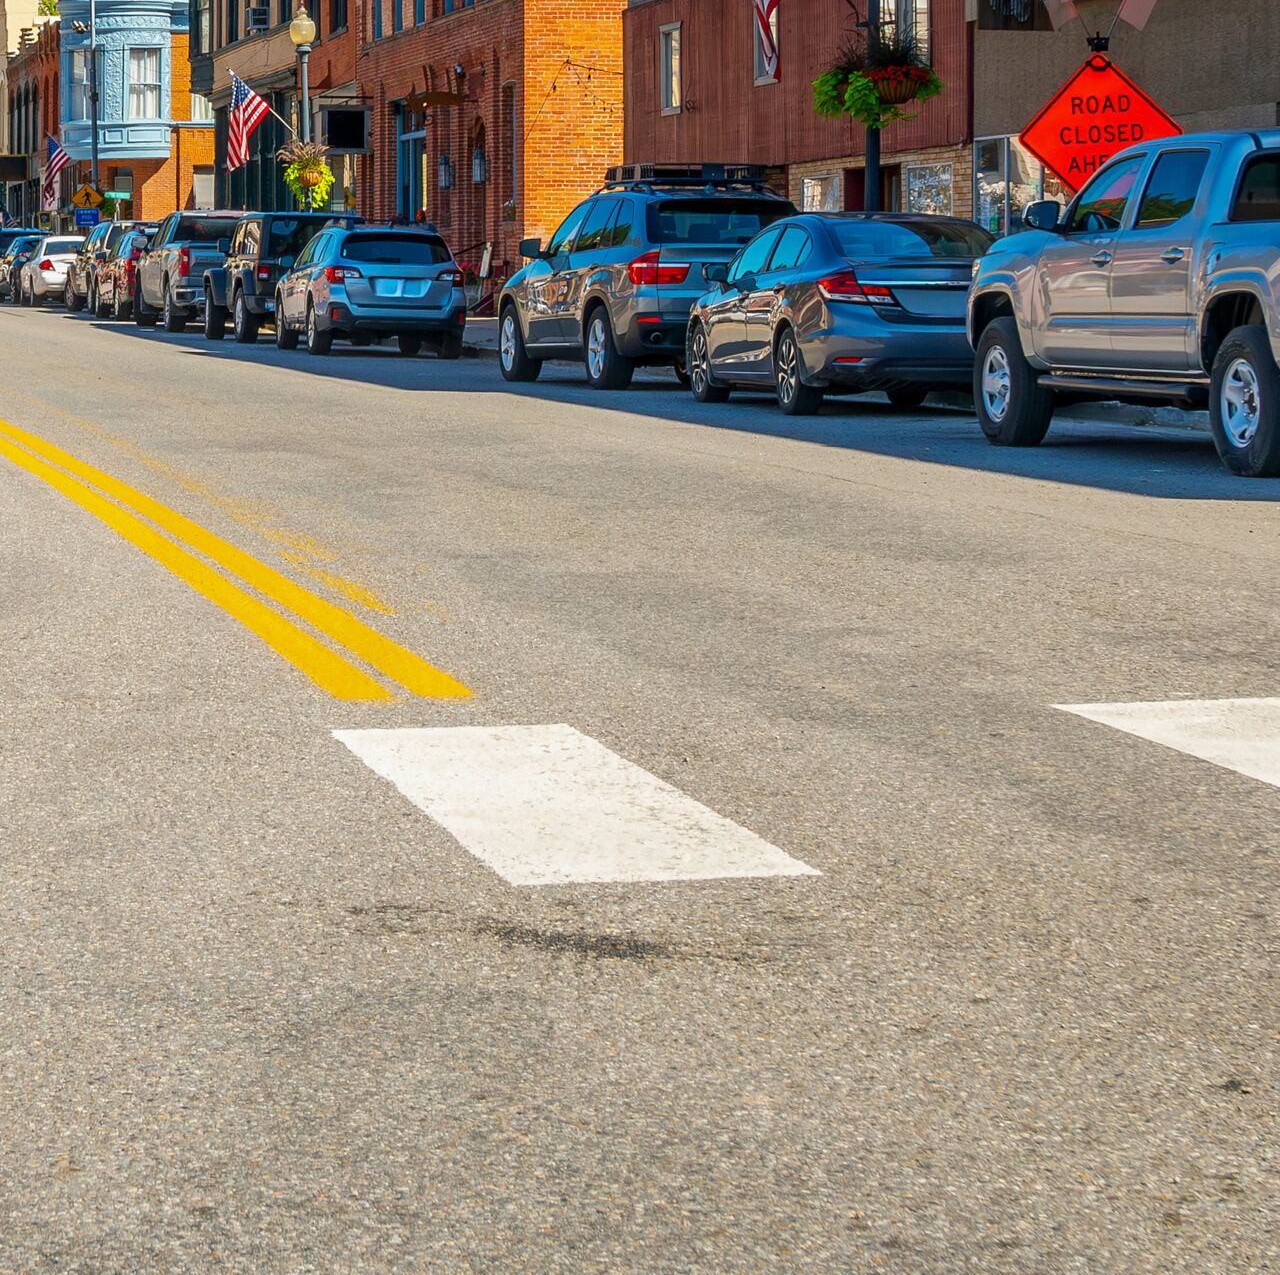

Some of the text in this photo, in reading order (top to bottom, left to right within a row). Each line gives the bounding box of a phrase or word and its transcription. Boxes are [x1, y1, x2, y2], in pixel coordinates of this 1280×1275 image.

[1071, 94, 1131, 115] ROAD
[1060, 123, 1144, 145] CLOSED
[1068, 154, 1110, 174] AHE
